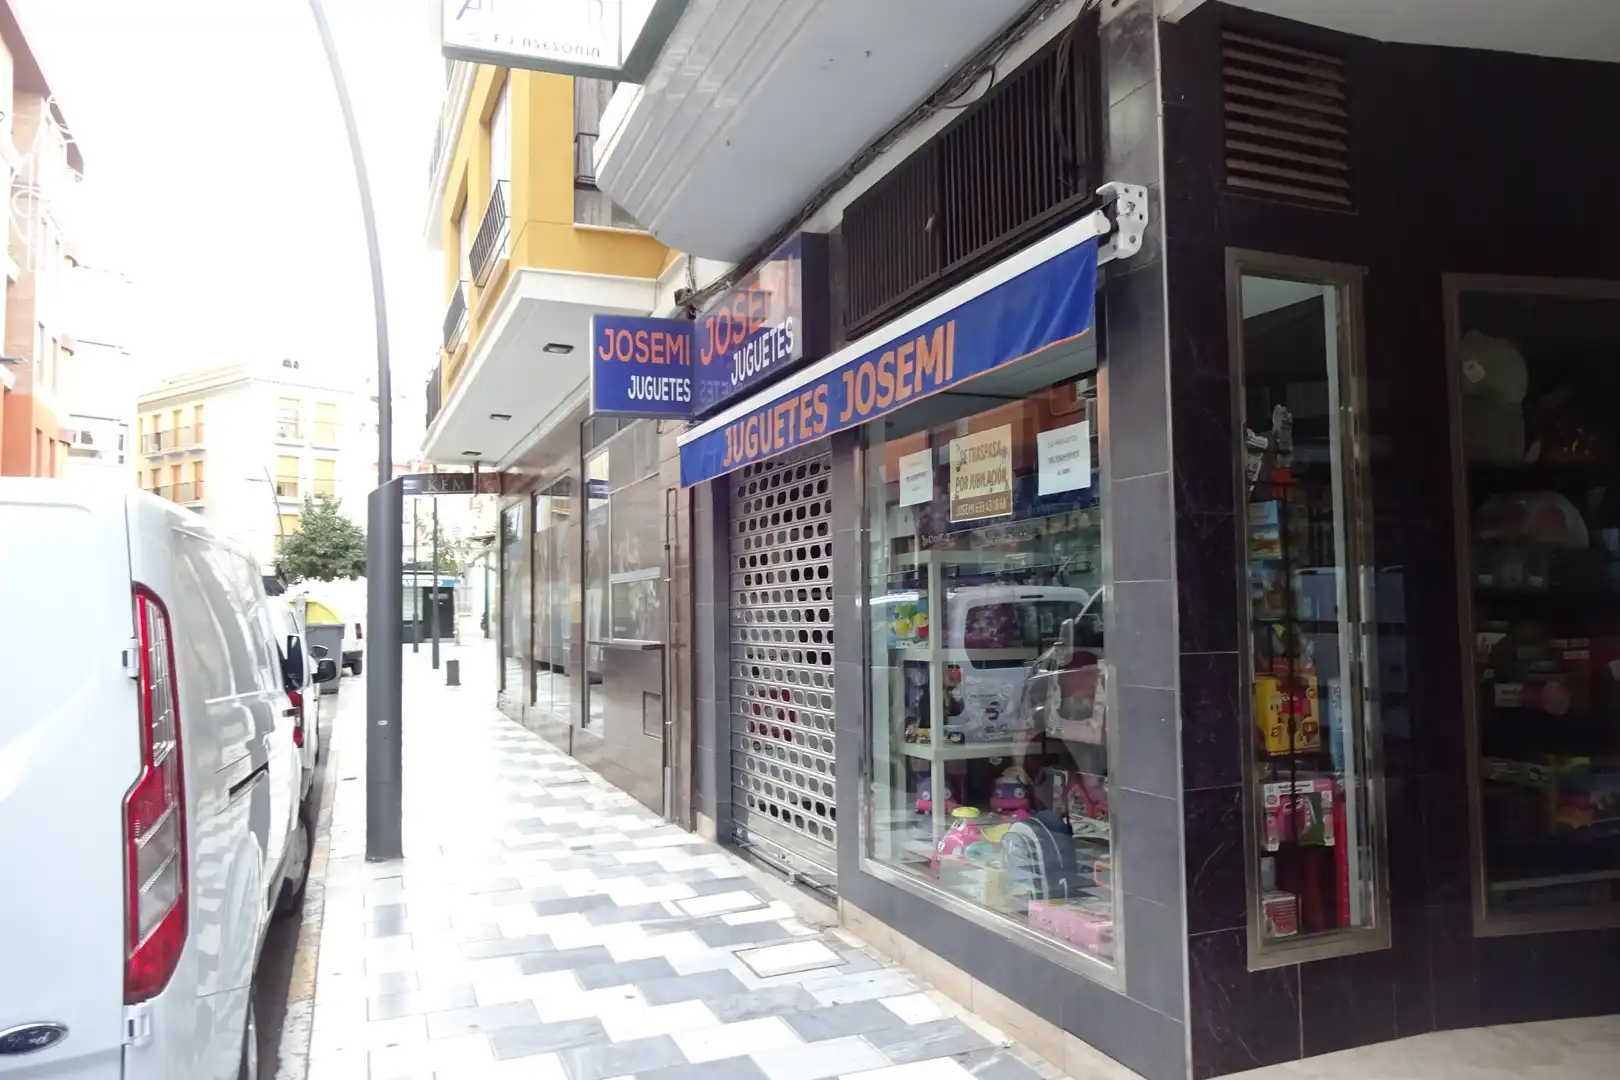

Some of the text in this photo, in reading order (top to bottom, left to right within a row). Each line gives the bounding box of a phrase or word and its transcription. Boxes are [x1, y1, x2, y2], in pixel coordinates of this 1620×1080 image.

[599, 328, 691, 367] JOSEMI
[731, 316, 794, 386] JUGUETES
[628, 375, 691, 402] JUGUETES
[722, 319, 956, 468] JUGUETES JOSEMI
[968, 440, 1002, 465] TRASPASA
[956, 475, 968, 493] POR
